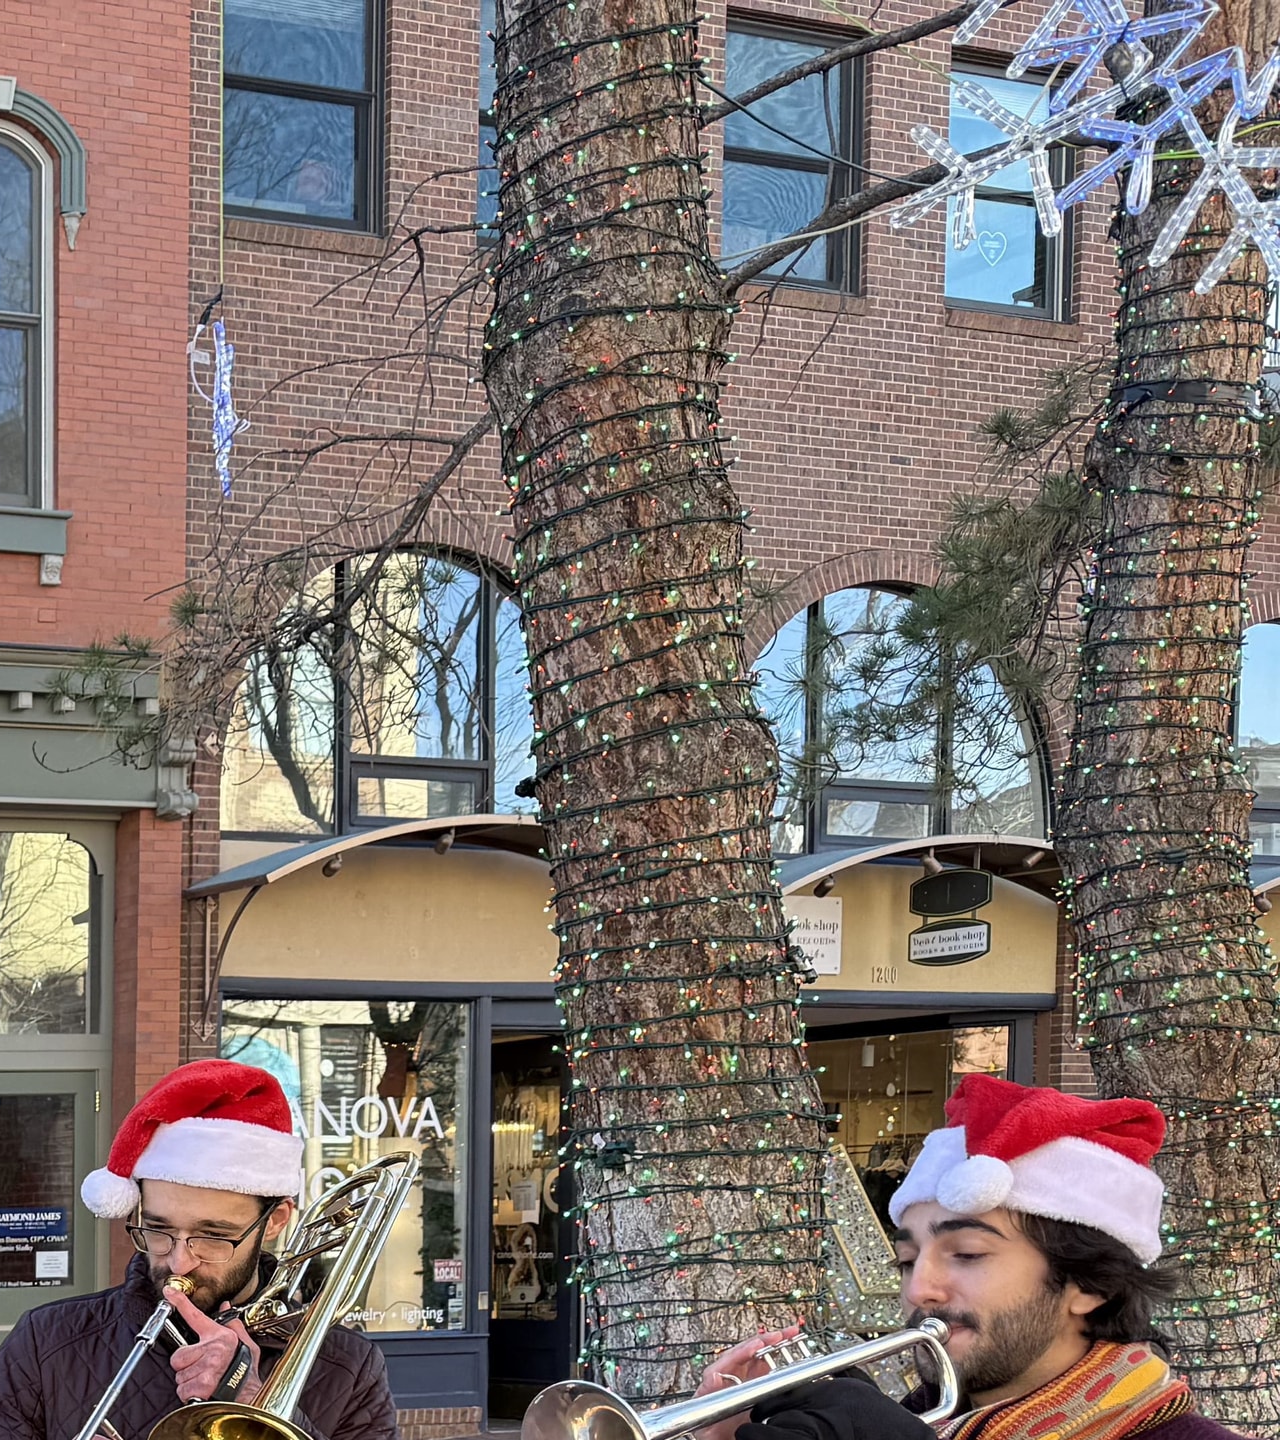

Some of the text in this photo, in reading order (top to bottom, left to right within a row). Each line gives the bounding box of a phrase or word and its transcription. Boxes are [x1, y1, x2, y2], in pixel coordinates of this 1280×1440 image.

[814, 919, 839, 934] shop
[938, 932, 960, 944] book
[962, 930, 985, 941] shop
[871, 966, 899, 984] 1200
[291, 1096, 444, 1139] ANOVA
[36, 1212, 62, 1221] JAMES
[401, 1306, 444, 1323] lighting
[227, 1361, 248, 1389] YAMAHA
